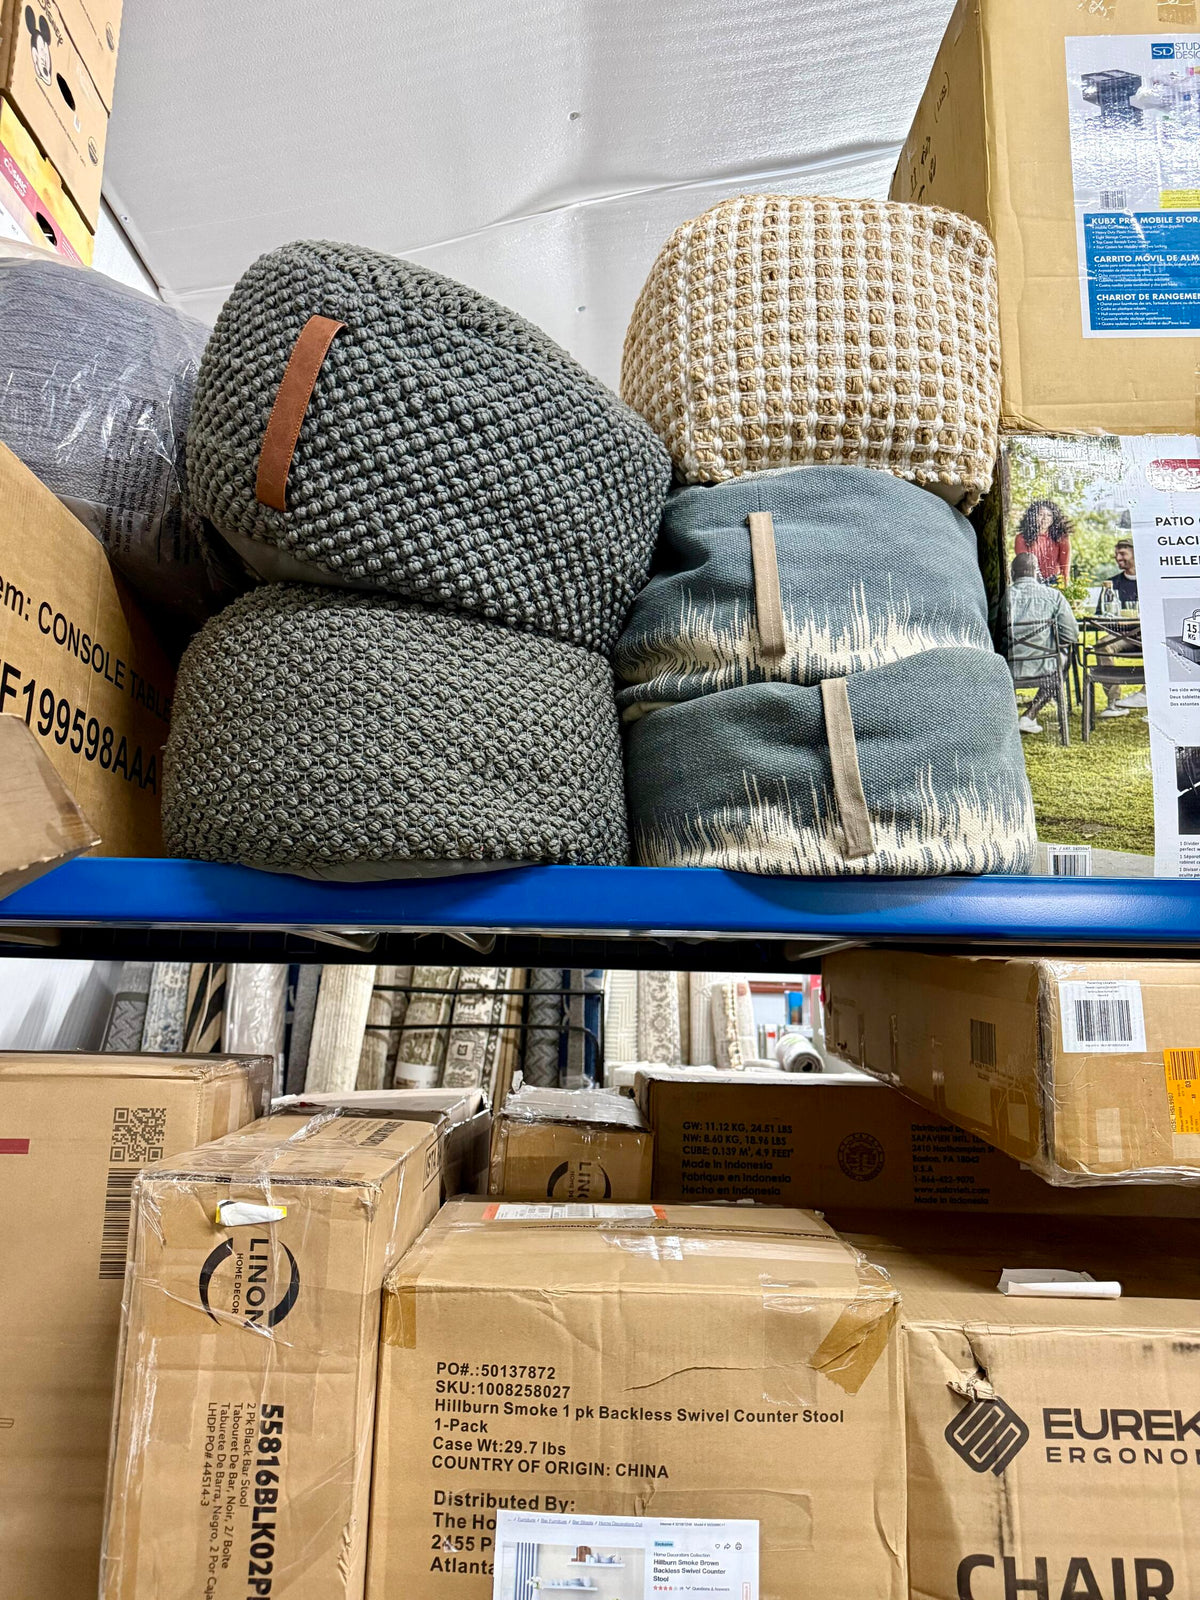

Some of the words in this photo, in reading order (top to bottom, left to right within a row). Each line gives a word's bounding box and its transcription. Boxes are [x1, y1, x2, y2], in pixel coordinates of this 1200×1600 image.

[1135, 253, 1165, 262] MÓVIL
[1155, 516, 1194, 526] PATIO
[1158, 536, 1199, 545] GLACI
[1187, 624, 1197, 633] 15
[38, 601, 125, 690] CONSOLE
[129, 669, 171, 724] TABLE
[0, 658, 157, 796] F199598AAA
[683, 1122, 702, 1130] GW:
[706, 1122, 729, 1131] 11.12
[750, 1124, 774, 1133] 24.51
[778, 1125, 792, 1134] LBS
[683, 1134, 702, 1142] NW:
[704, 1135, 723, 1143] 8.60
[745, 1136, 768, 1145] 18.96
[772, 1137, 786, 1145] LBS
[712, 1147, 736, 1156] 0.139
[755, 1148, 769, 1157] 4.9
[682, 1160, 710, 1169] Made
[725, 1160, 773, 1170] Indonesia
[682, 1172, 724, 1182] Fabrique
[743, 1173, 792, 1183] Indonesia
[682, 1185, 713, 1194] Hecho
[732, 1186, 781, 1195] Indonesia
[234, 1252, 243, 1280] HOME
[244, 1238, 269, 1329] LINON
[231, 1282, 242, 1315] DECOR
[436, 1361, 556, 1381] PO#.:50137872
[435, 1380, 571, 1399] SKU:1008258027
[206, 1402, 218, 1434] LHDP
[247, 1412, 256, 1426] Pk
[434, 1399, 499, 1415] Hillburn
[503, 1402, 558, 1418] Smoke
[574, 1405, 595, 1422] pk
[599, 1406, 673, 1422] Backless
[677, 1408, 730, 1423] Swivel
[733, 1409, 798, 1424] Counter
[802, 1410, 845, 1424] Stool
[217, 1403, 230, 1452] Taburete
[230, 1403, 243, 1452] Tabouret
[434, 1418, 488, 1434] 1-Pack
[1042, 1408, 1200, 1441] EUREK
[204, 1436, 214, 1459] PO#
[244, 1428, 255, 1456] Black
[433, 1437, 473, 1452] Case
[477, 1438, 538, 1455] Wt:29.7
[542, 1440, 566, 1456] lbs
[216, 1454, 226, 1469] De
[229, 1455, 239, 1469] De
[243, 1459, 252, 1477] Bar
[432, 1456, 514, 1473] COUNTRY
[518, 1458, 541, 1473] OF
[545, 1460, 611, 1477] ORIGIN:
[615, 1462, 669, 1479] CHINA
[201, 1462, 213, 1506] 44514-3
[214, 1471, 225, 1502] Barra,
[228, 1472, 238, 1493] Bar,
[240, 1480, 251, 1507] Stool
[225, 1496, 236, 1522] Noir,
[434, 1490, 541, 1510] Distributed
[545, 1494, 576, 1514] By:
[209, 1506, 222, 1542] Negro,
[432, 1513, 469, 1529] The
[474, 1514, 496, 1530] Ho
[222, 1540, 233, 1569] Boîte
[480, 1536, 495, 1552] P
[208, 1556, 219, 1574] Por
[204, 1576, 217, 1600] Caja
[956, 1554, 1176, 1600] CHAIR
